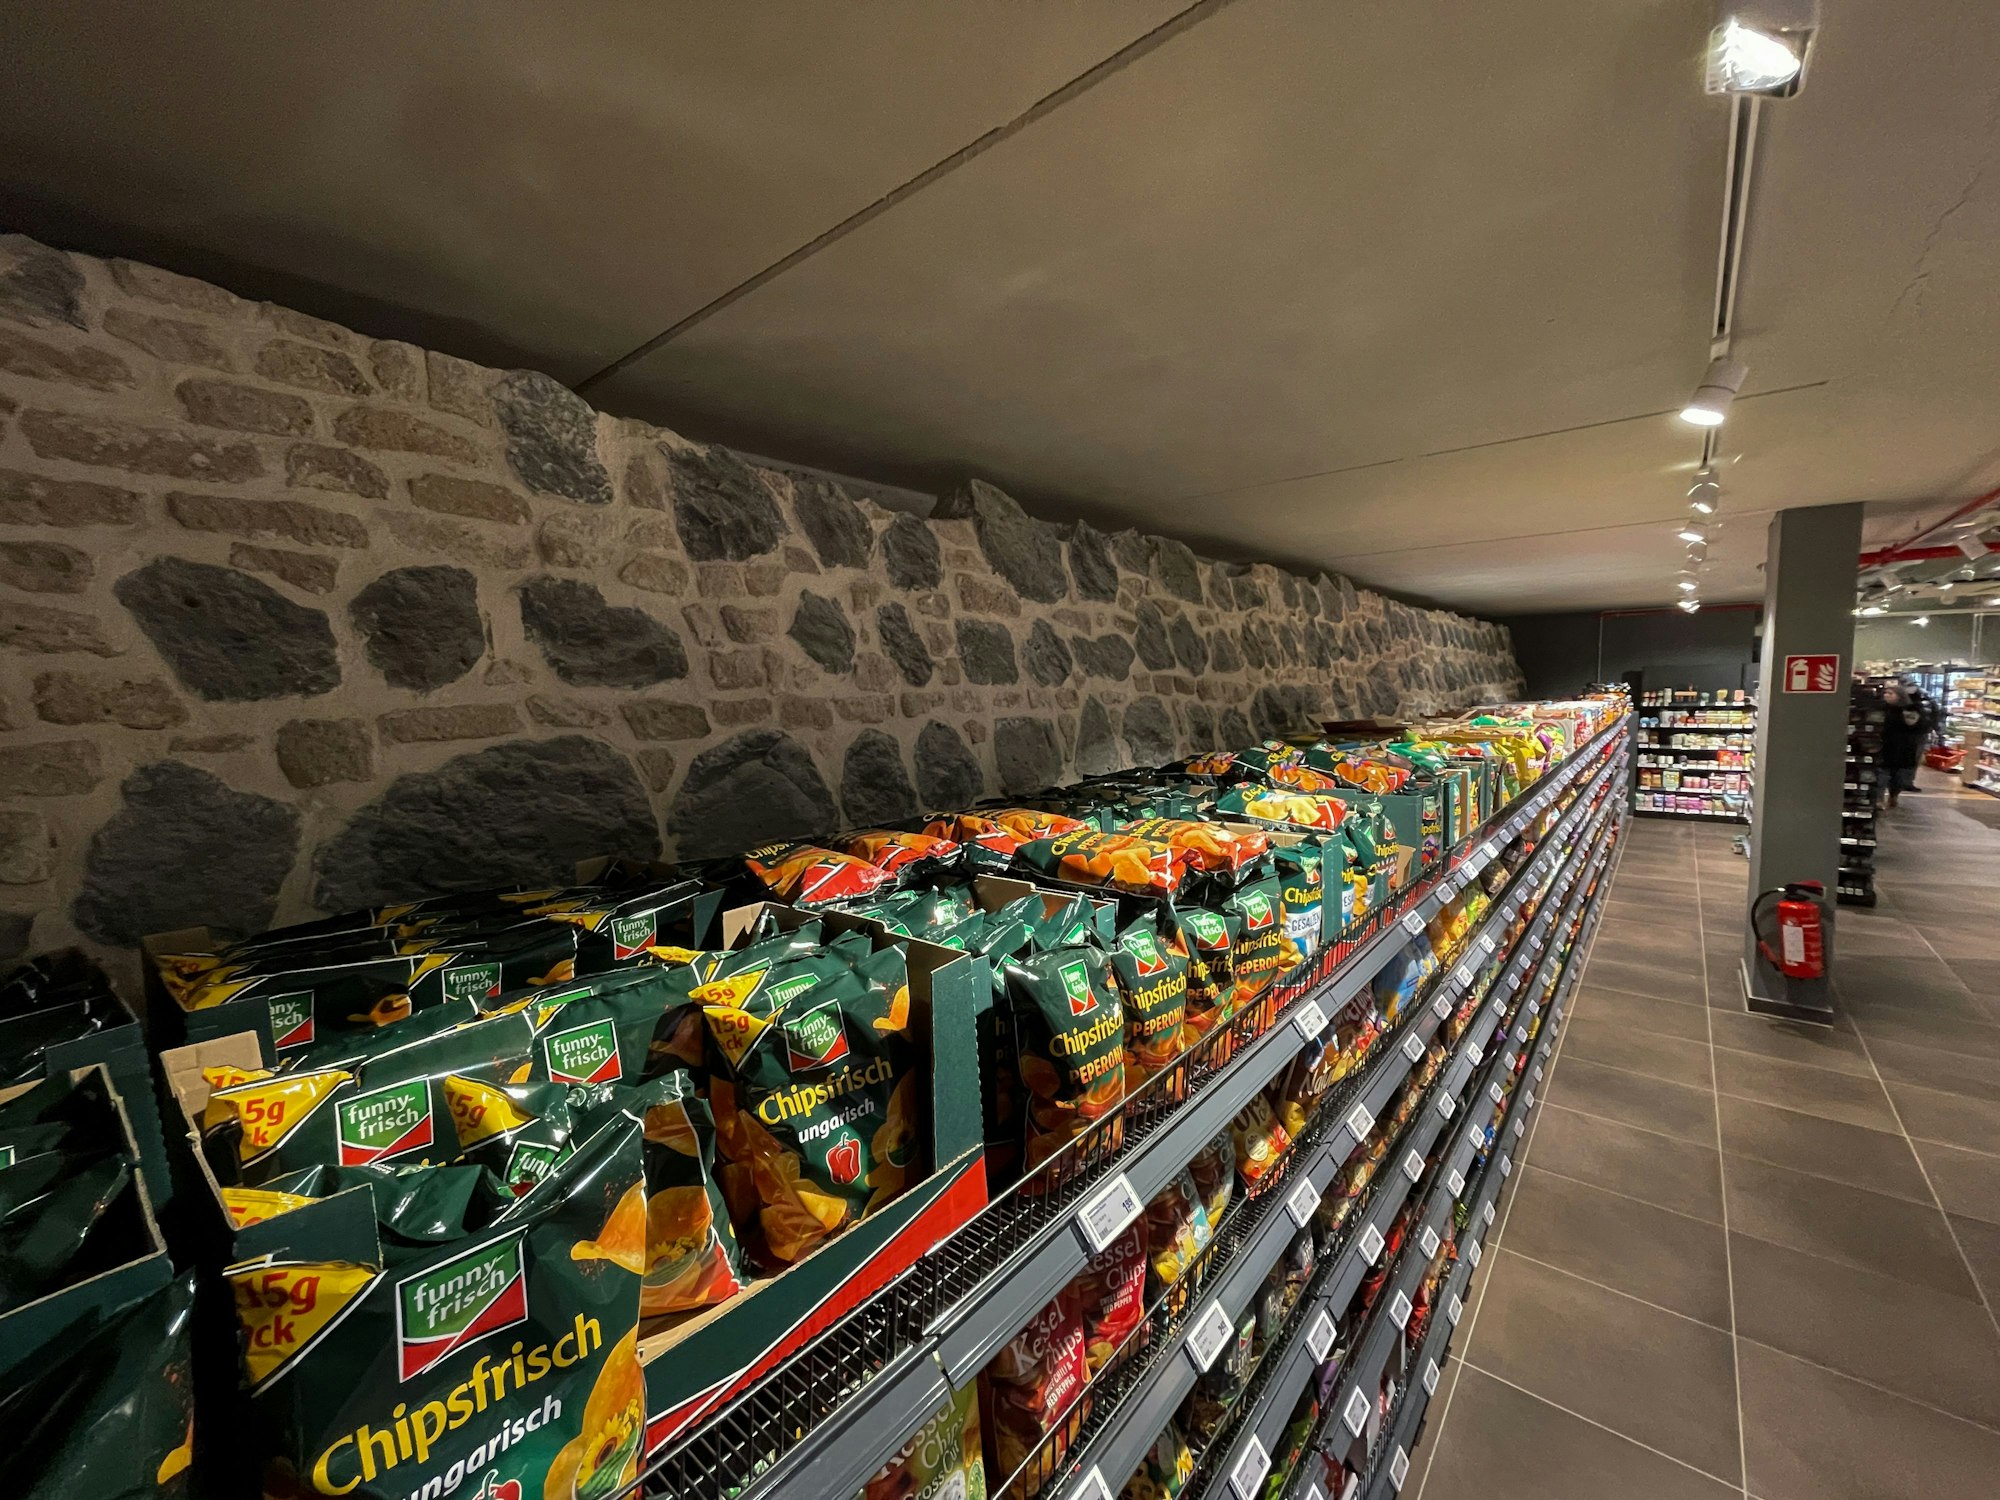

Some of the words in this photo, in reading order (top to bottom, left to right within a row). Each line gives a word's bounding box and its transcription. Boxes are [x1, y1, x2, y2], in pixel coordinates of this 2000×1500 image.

[617, 919, 649, 934] funny-
[622, 926, 651, 943] frisch
[449, 970, 492, 986] funny-
[455, 978, 494, 995] frisch
[271, 1011, 303, 1029] isch
[793, 1014, 831, 1040] funny-
[553, 1034, 604, 1056] funny-
[801, 1026, 837, 1052] frisch
[562, 1046, 609, 1070] frisch
[758, 1056, 893, 1125] Chipsfrisch
[348, 1095, 416, 1124] funny-
[798, 1098, 875, 1144] ungarisch
[358, 1111, 419, 1140] frisch
[1085, 1226, 1141, 1273] essel
[413, 1254, 505, 1313] funny-
[1106, 1260, 1146, 1290] Chips
[427, 1268, 506, 1329] frisch
[312, 1313, 602, 1496] Chipsfrisch
